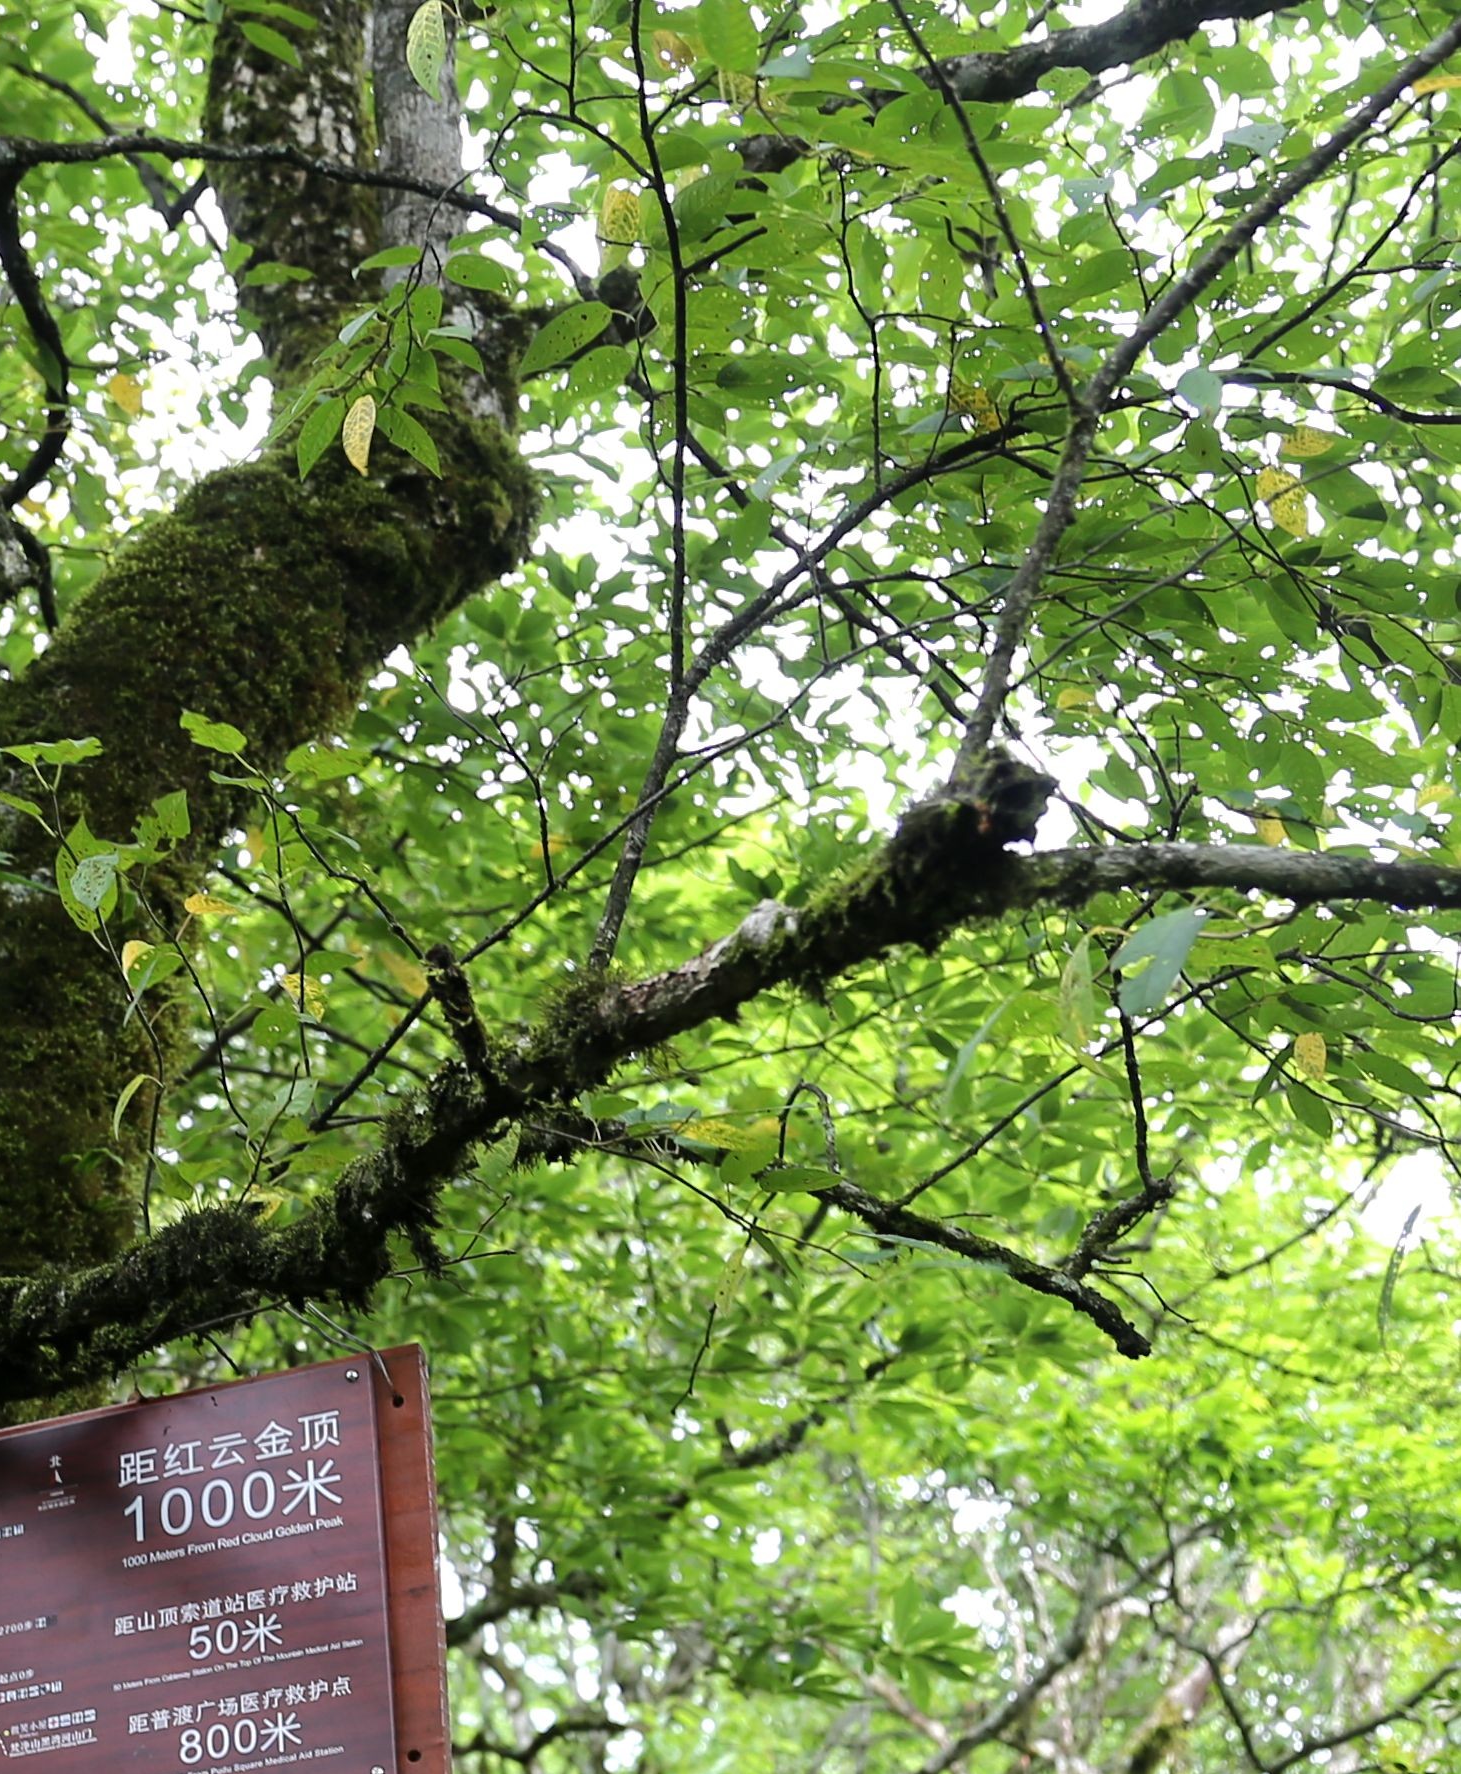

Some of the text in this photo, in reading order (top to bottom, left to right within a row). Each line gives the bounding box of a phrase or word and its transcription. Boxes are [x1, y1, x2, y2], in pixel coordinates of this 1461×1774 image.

[49, 1455, 62, 1468] 北
[118, 1410, 340, 1488] 距红云金顶
[124, 1458, 342, 1542] 1000米
[122, 1515, 344, 1568] 1000 Meters From Red Cloud Golden Peak
[114, 1571, 358, 1637] 距山顶索道站医疗救护站
[189, 1613, 283, 1660] 50米
[144, 1677, 161, 1686] From
[214, 1664, 225, 1673] On
[226, 1662, 238, 1670] The
[239, 1659, 252, 1669] Top
[263, 1654, 275, 1664] The
[276, 1649, 304, 1661] Mountain
[128, 1675, 352, 1735] 距普渡广场医疗救护点
[179, 1711, 302, 1765] 800米
[234, 1761, 263, 1773] Square
[264, 1753, 298, 1767] Medical
[298, 1751, 313, 1760] Aid
[314, 1746, 345, 1758] Station
